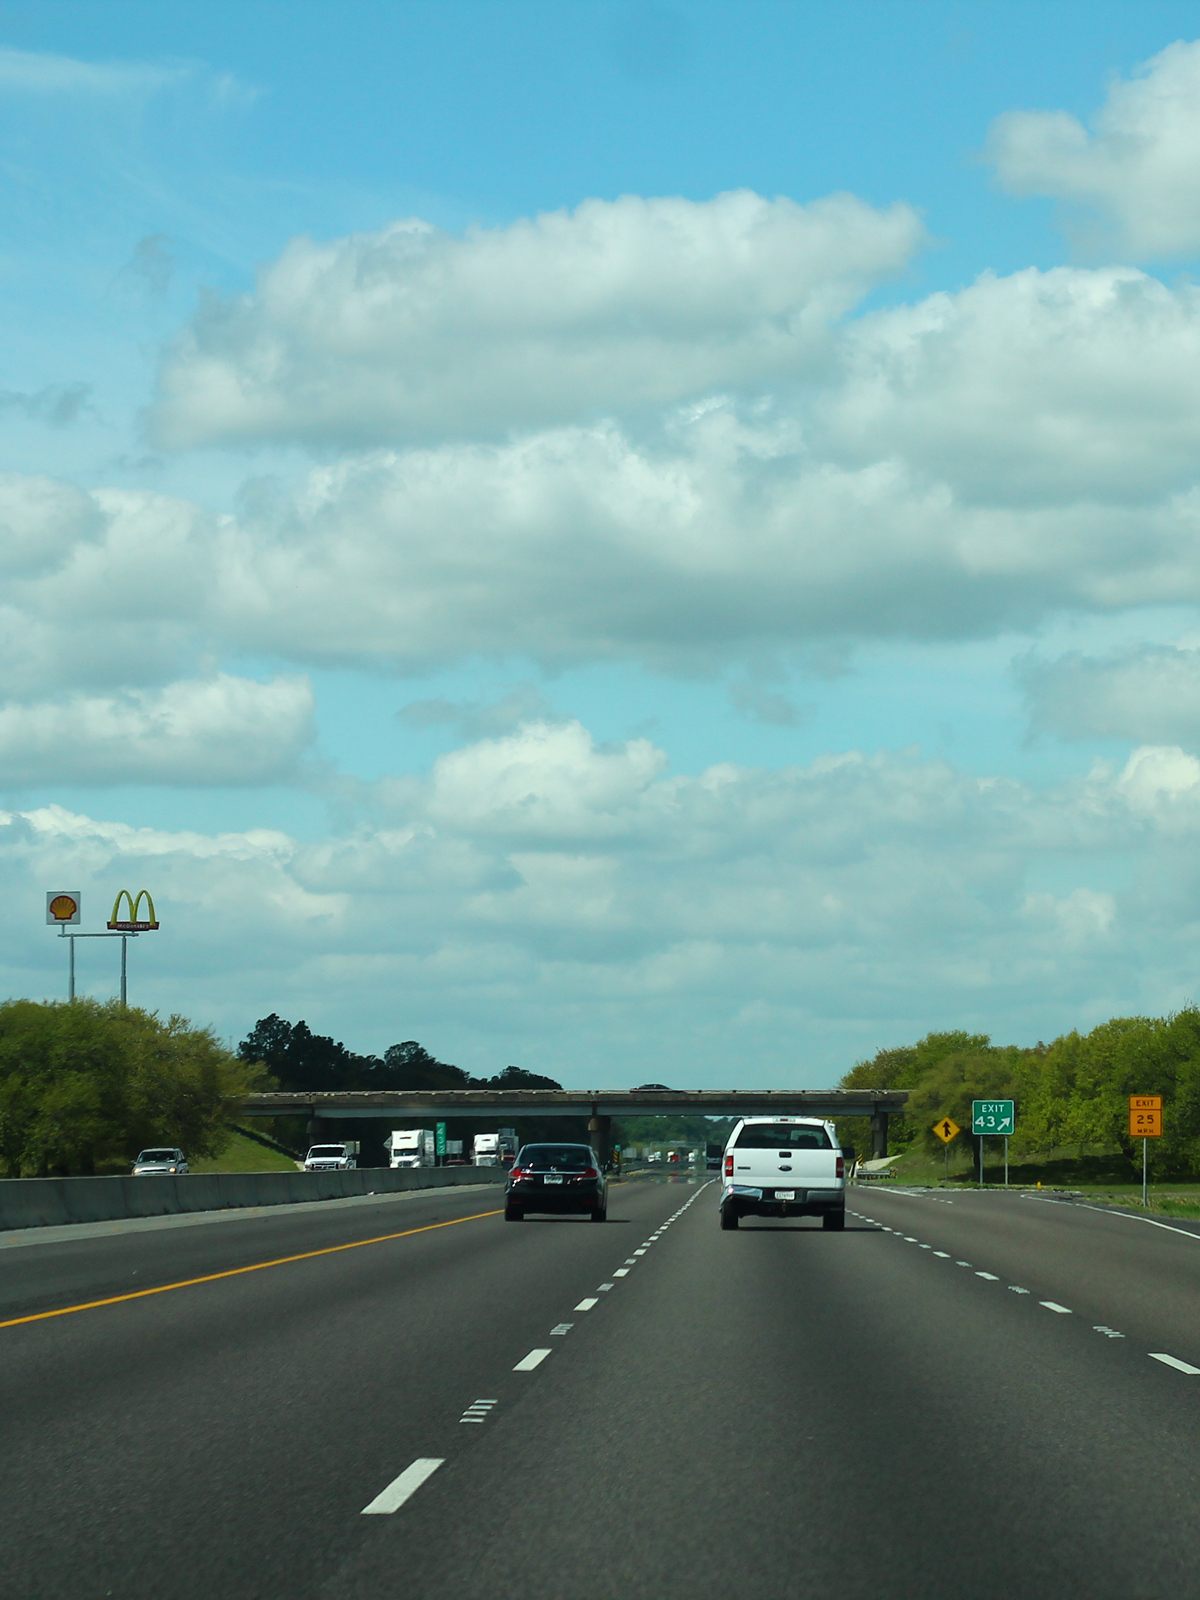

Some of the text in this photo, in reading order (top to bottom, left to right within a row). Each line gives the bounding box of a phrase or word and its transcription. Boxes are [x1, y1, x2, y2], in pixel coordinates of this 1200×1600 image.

[1136, 1099, 1154, 1107] EXIT
[981, 1104, 1005, 1113] EXIT
[975, 1115, 996, 1127] 43
[1136, 1114, 1155, 1125] 25
